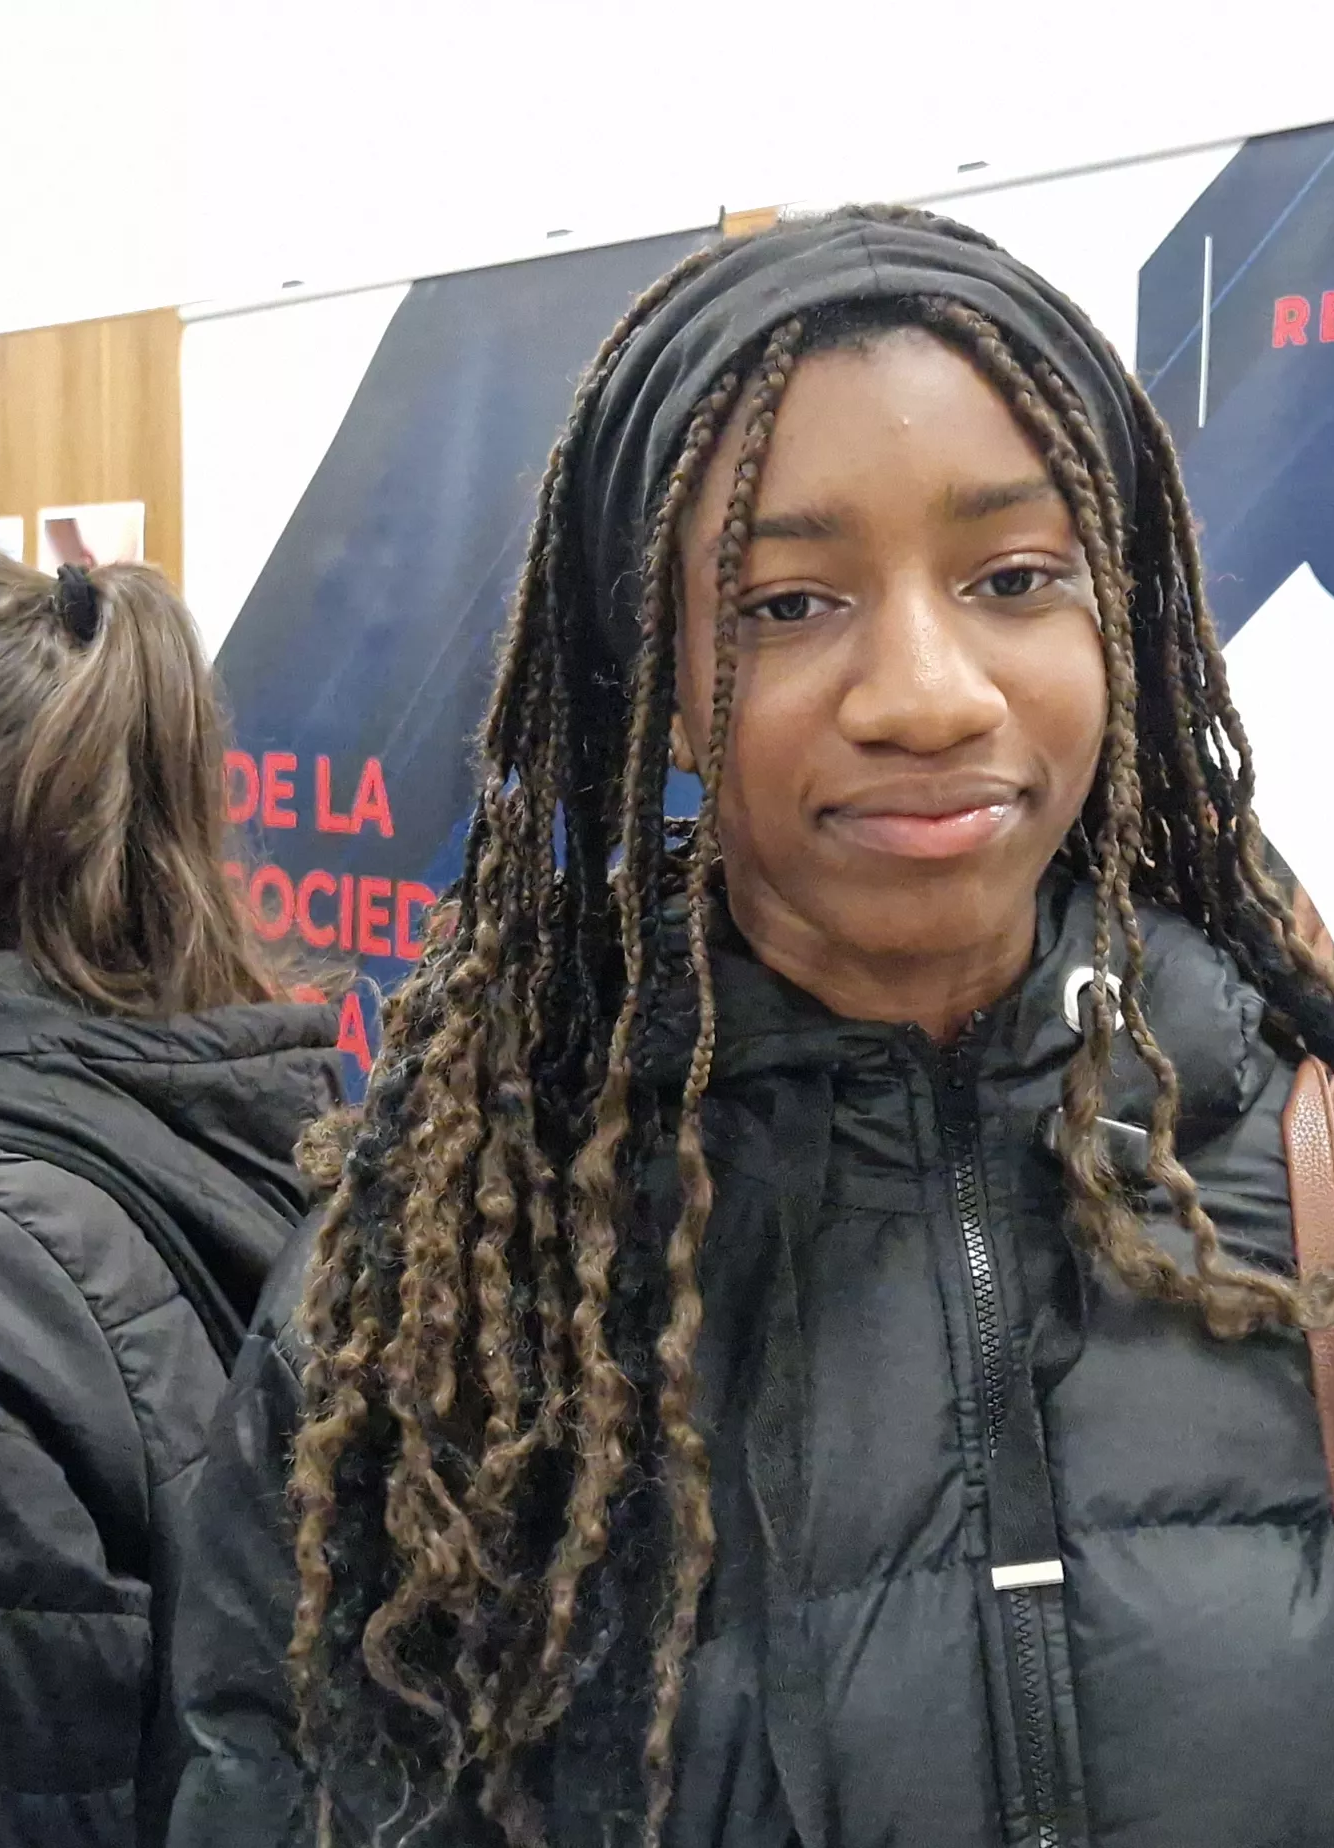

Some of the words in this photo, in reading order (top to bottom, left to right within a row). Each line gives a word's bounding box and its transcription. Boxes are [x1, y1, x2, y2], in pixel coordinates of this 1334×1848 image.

[222, 749, 298, 829] DE
[314, 754, 395, 839] LA
[222, 861, 440, 962] OCIED
